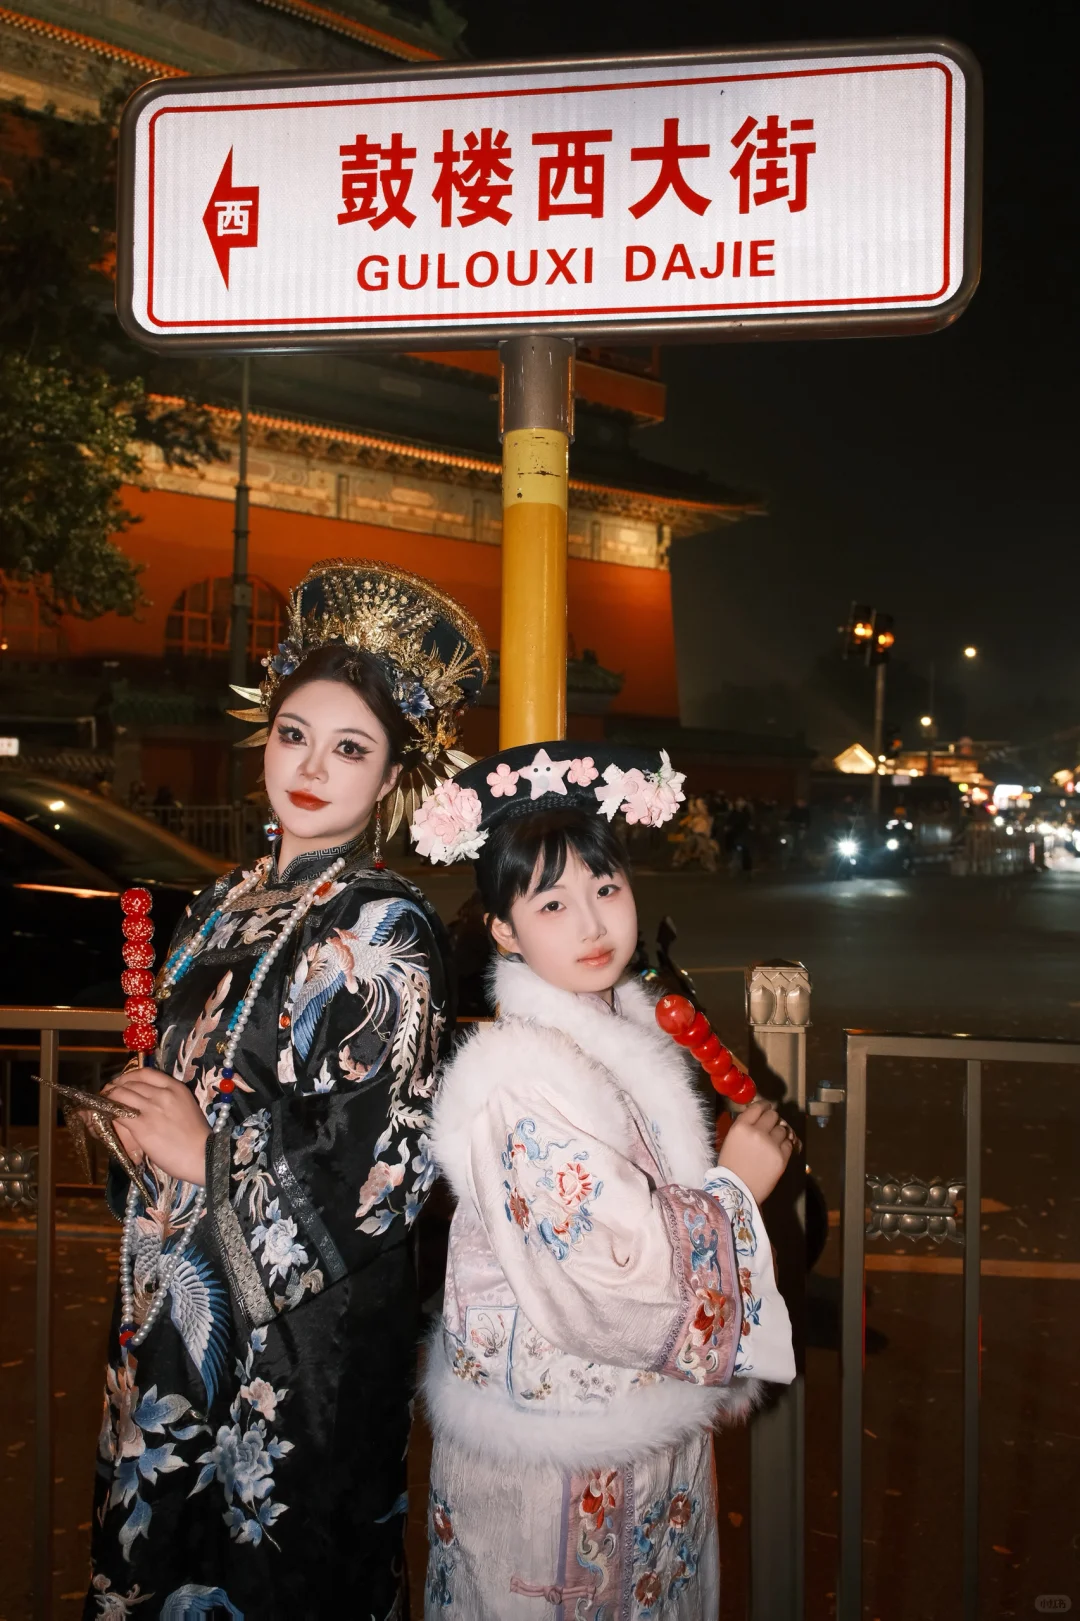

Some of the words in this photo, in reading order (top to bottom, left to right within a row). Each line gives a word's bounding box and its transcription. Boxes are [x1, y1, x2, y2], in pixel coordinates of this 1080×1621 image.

[337, 114, 816, 231] 鼓楼西大街
[214, 200, 253, 237] 西
[357, 247, 593, 291] GULOUXI
[625, 240, 775, 282] DAJIE
